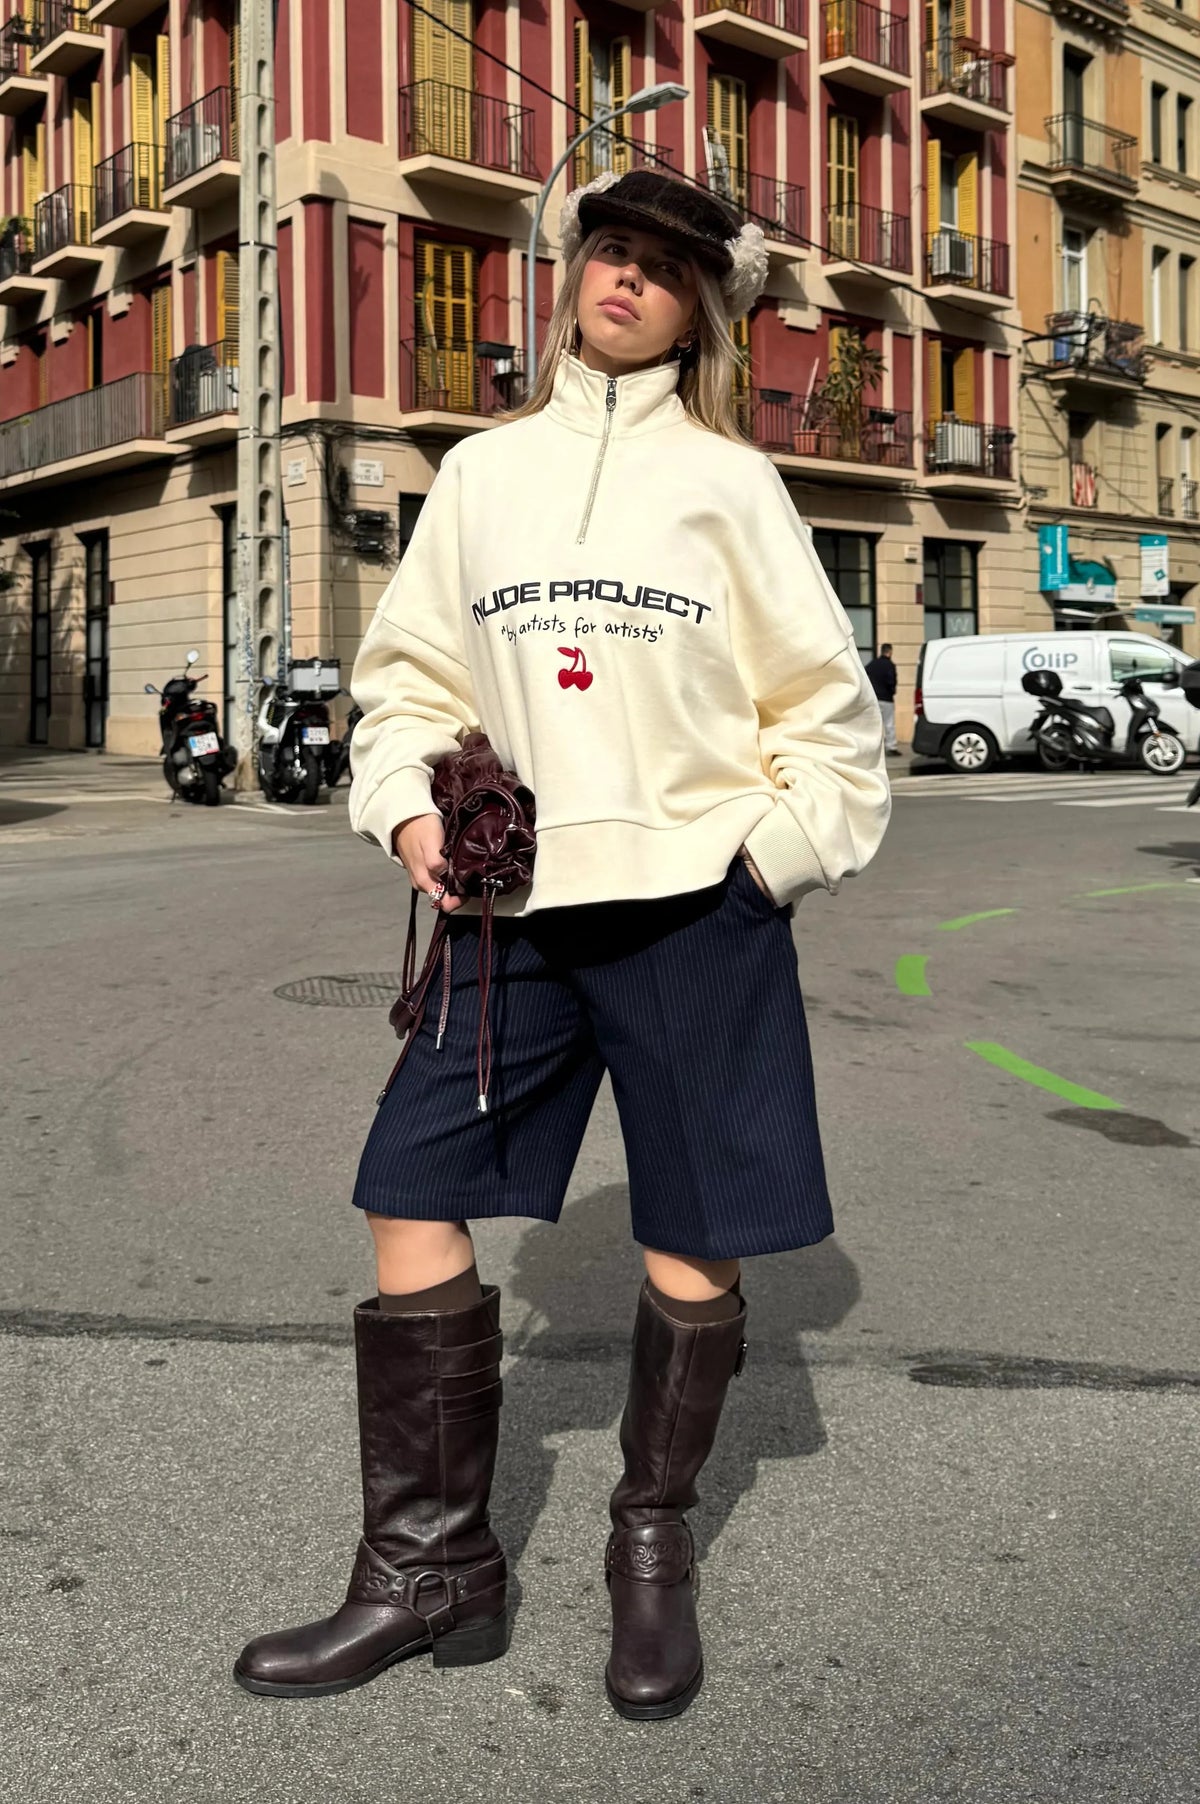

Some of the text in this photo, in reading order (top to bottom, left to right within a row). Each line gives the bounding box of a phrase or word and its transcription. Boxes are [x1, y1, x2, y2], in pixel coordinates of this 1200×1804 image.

[471, 579, 712, 626] NUDE PROJECT
[519, 614, 566, 633] artists
[574, 616, 597, 638] for
